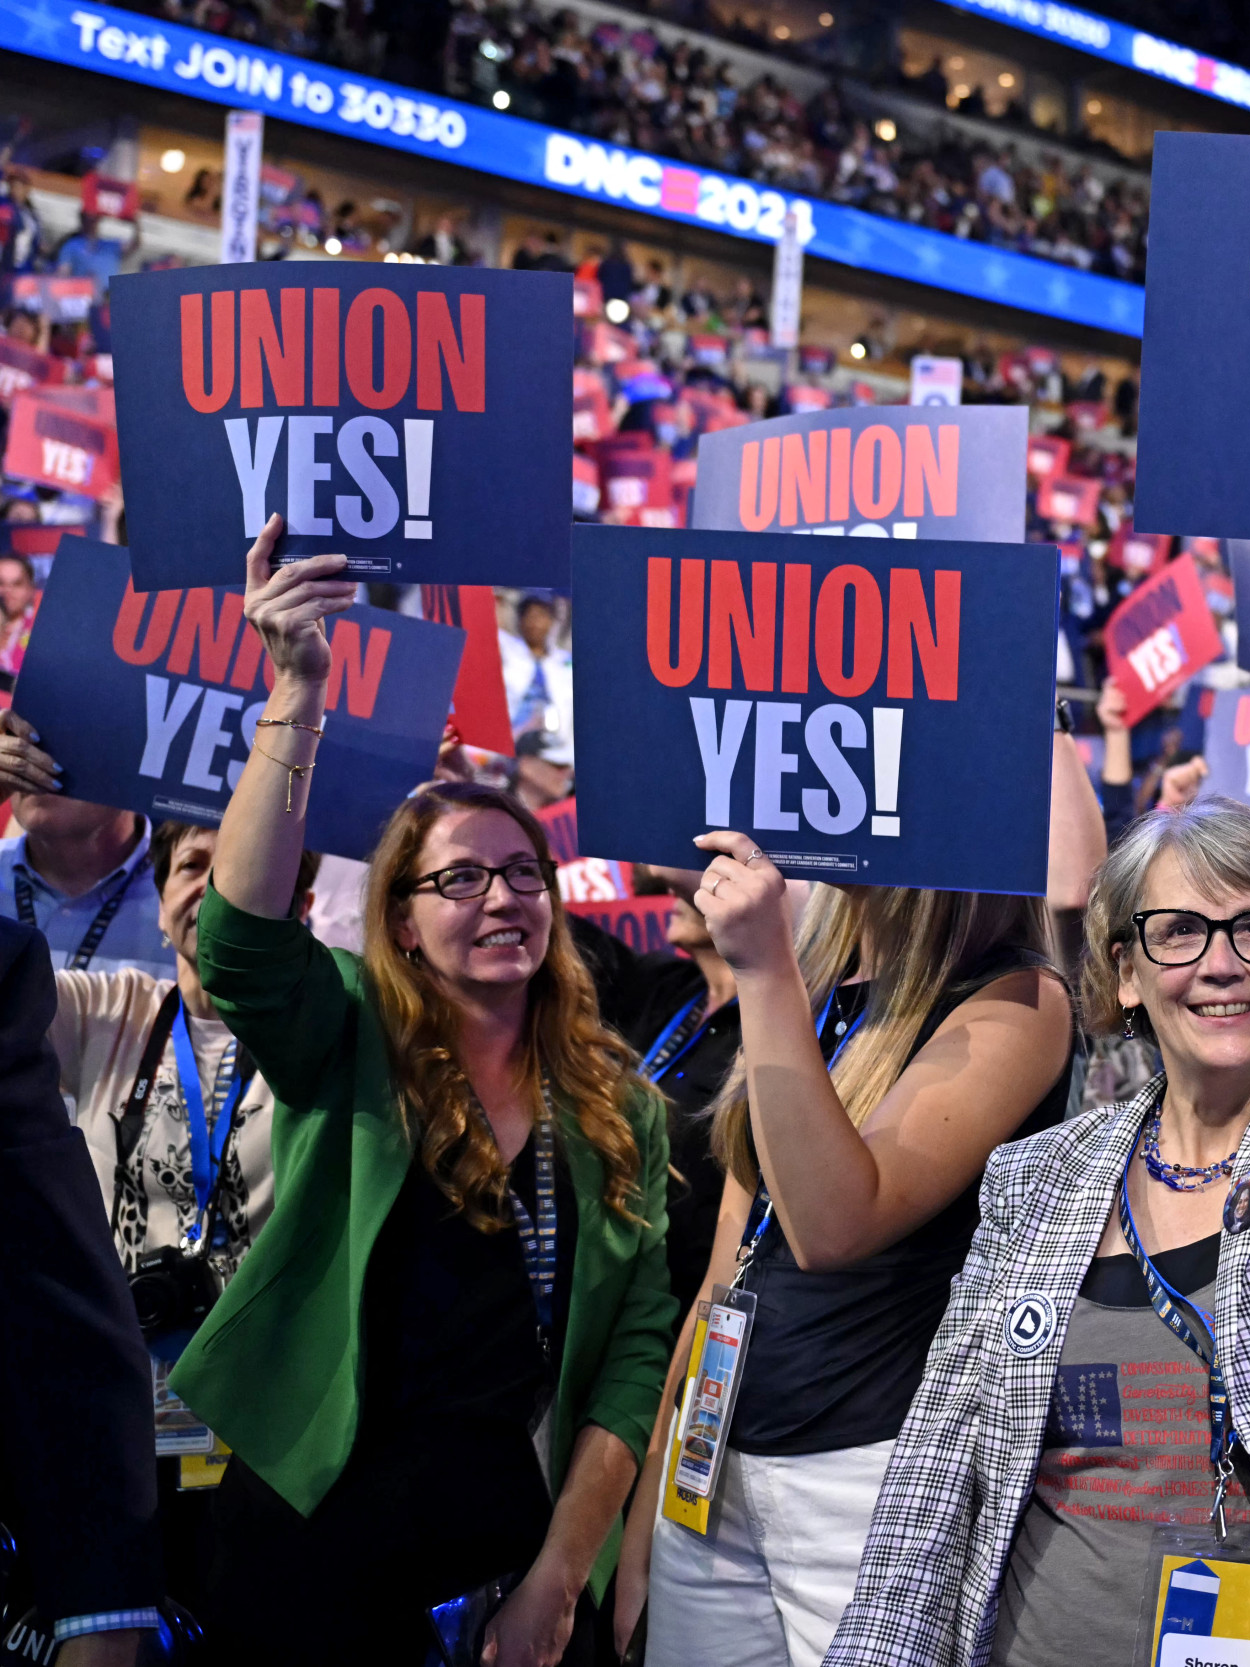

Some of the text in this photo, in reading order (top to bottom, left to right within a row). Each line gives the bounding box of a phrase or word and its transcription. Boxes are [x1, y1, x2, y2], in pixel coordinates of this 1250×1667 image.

[71, 10, 467, 148] Text JOIN to 30330
[545, 133, 664, 207] DNC
[180, 287, 486, 413] UNION
[224, 415, 435, 540] YES!
[739, 424, 960, 532] UNION
[112, 575, 392, 720] UNIN
[646, 557, 962, 701] UNION
[689, 697, 904, 837] YES!
[134, 1078, 149, 1100] EOS
[140, 1258, 163, 1269] Canon
[1016, 1335, 1046, 1353] COMMITTEE
[6, 1622, 56, 1666] UNI
